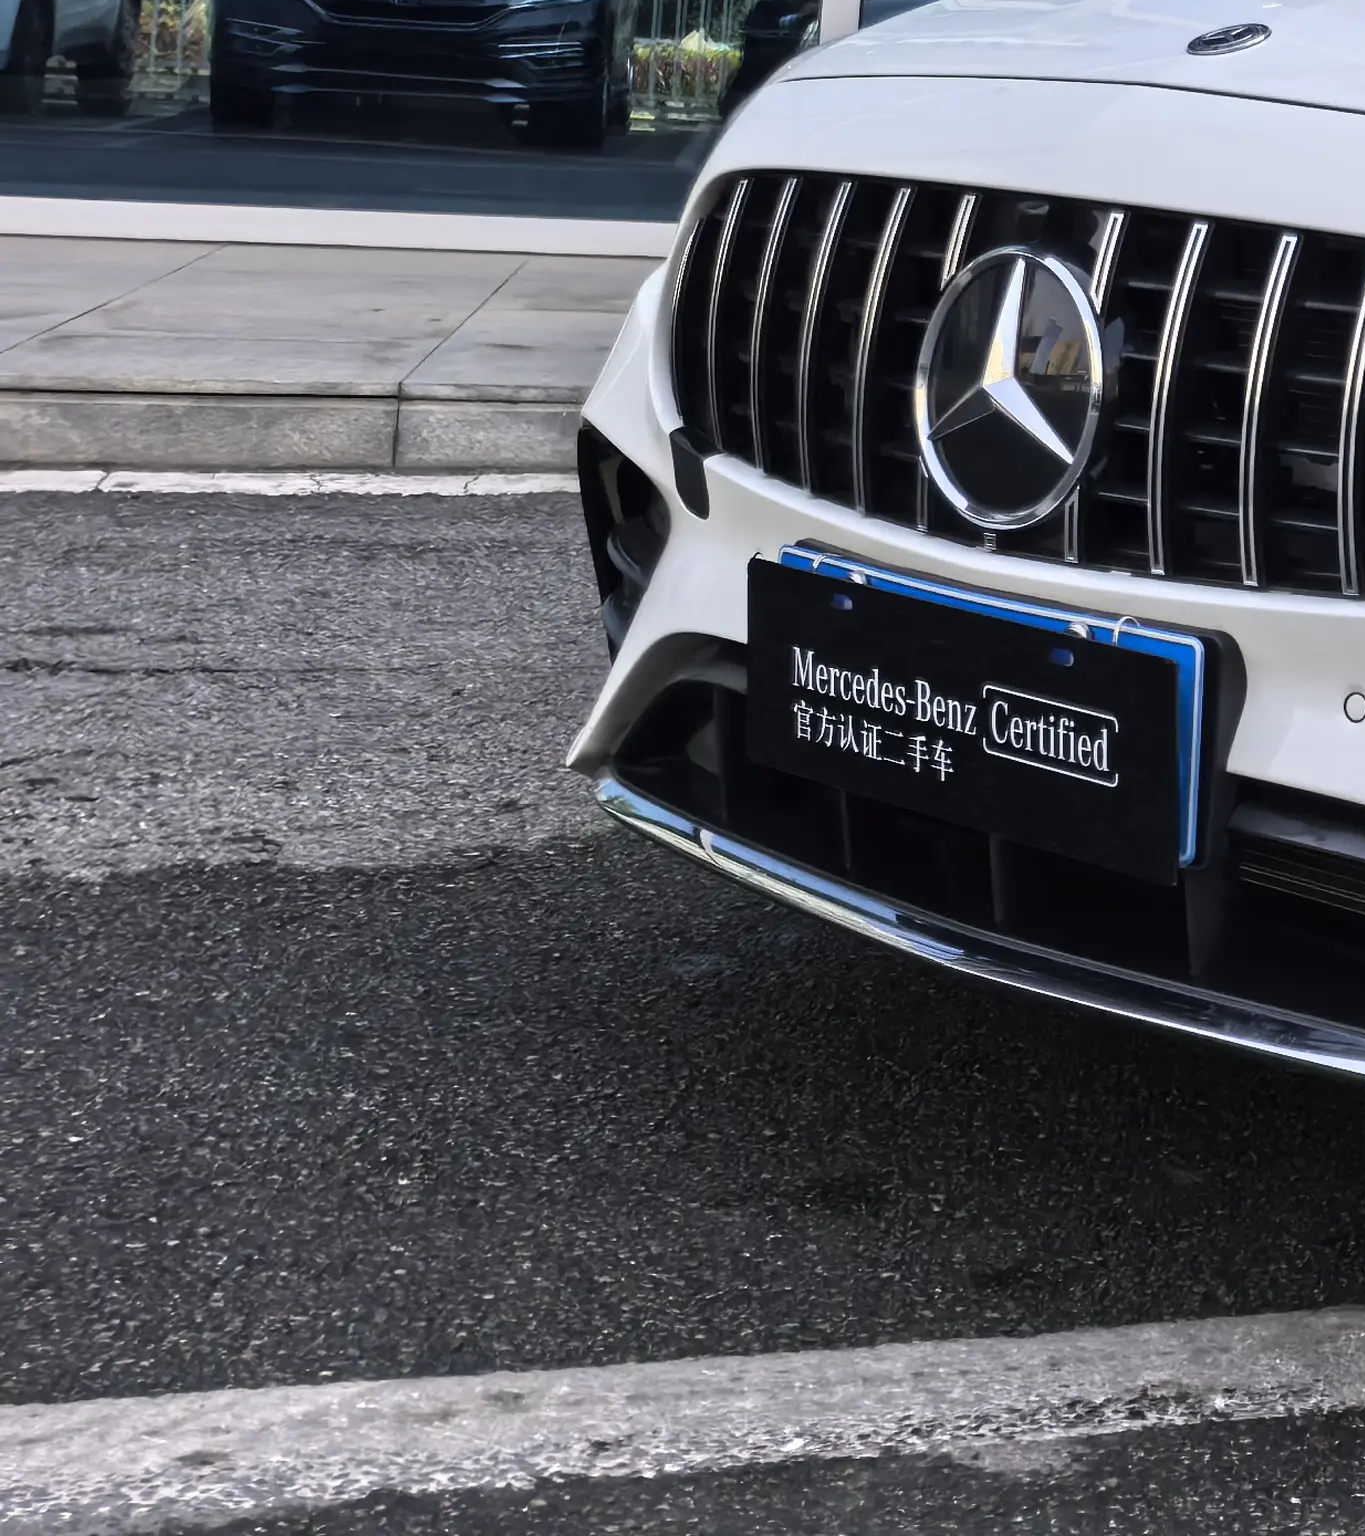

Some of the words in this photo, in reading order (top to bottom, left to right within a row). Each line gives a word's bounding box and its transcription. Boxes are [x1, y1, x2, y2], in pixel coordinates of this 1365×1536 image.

[793, 646, 977, 736] Mercedes-Benz
[991, 700, 1109, 772] Certified
[793, 700, 955, 781] 官方认证二手车
